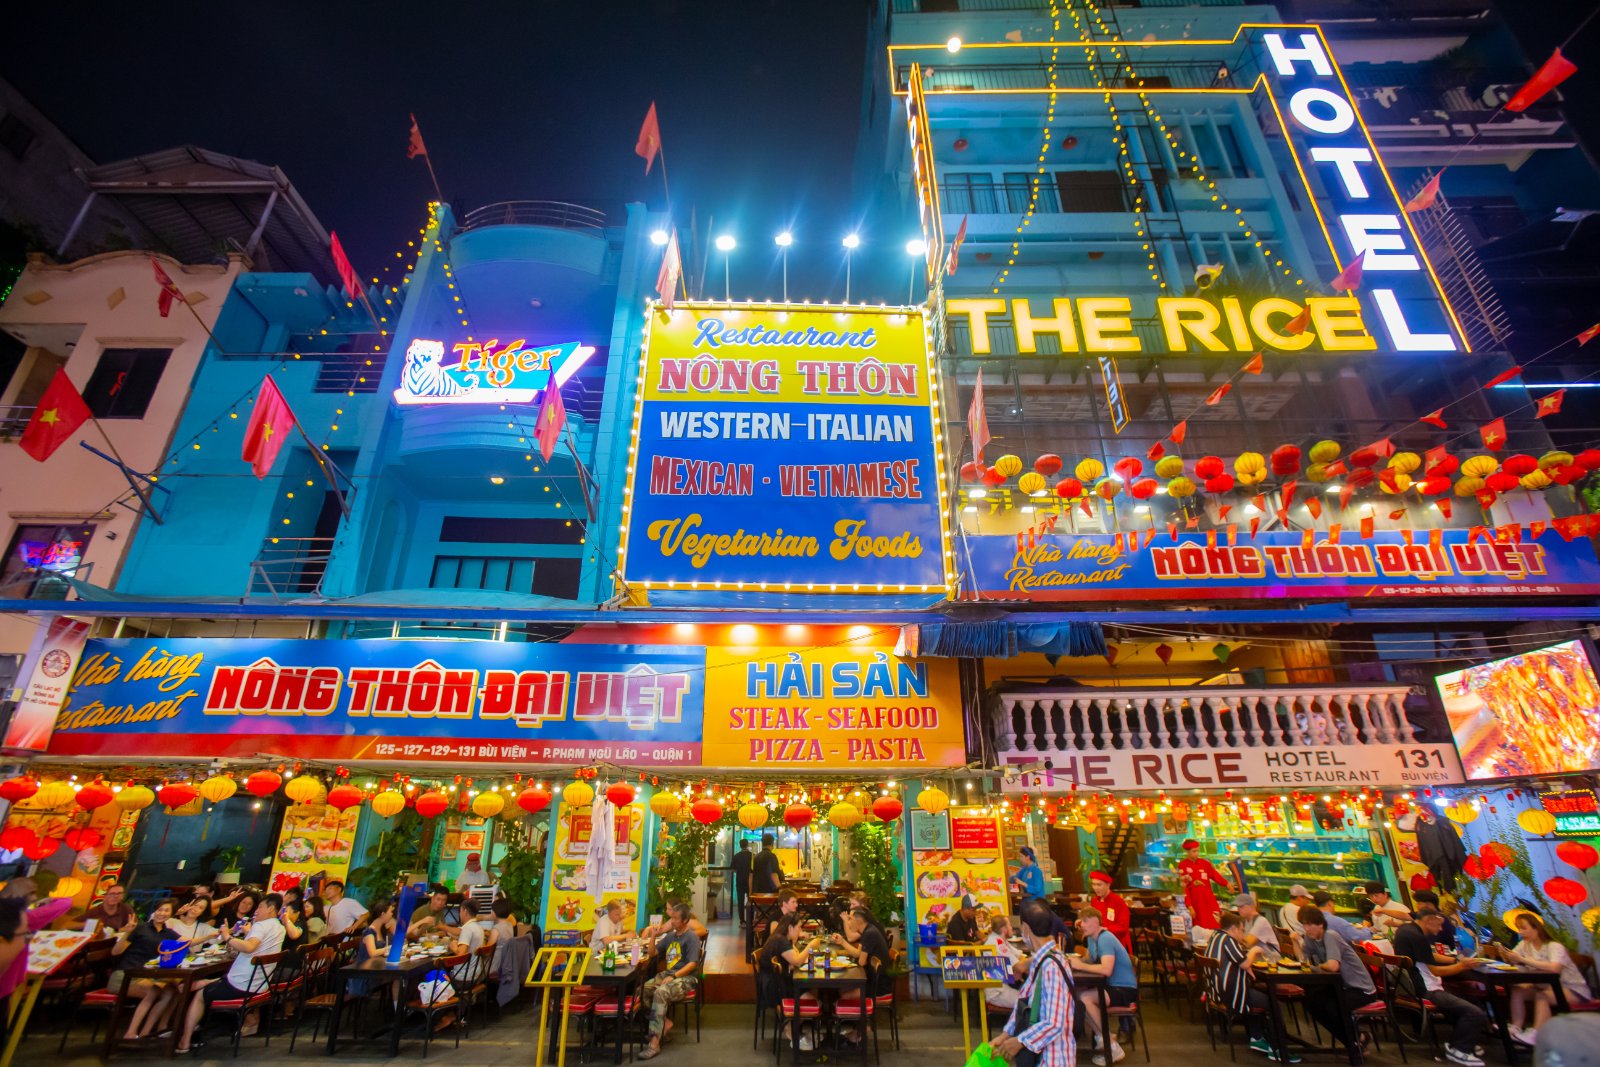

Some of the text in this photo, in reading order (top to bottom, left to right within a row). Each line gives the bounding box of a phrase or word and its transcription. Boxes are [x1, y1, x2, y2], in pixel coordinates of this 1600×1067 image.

[1263, 34, 1457, 351] HOTEL
[692, 318, 877, 349] Restaurant
[946, 297, 1378, 354] THE RICE
[452, 339, 562, 388] Tiger
[657, 353, 918, 398] NÔNG THÔN
[649, 455, 754, 496] MEXICAN
[779, 459, 922, 499] VIETNAMESE
[647, 513, 923, 568] Vegetarian Foods
[1150, 540, 1267, 580] NÔNG
[1375, 543, 1454, 581] ĐẠI
[1004, 563, 1133, 593] Restaurant
[123, 646, 204, 692] hàng
[746, 652, 930, 699] HẢI SẢN
[56, 690, 199, 730] estaurant
[203, 657, 690, 730] NÔNG THÔN ĐẠI VIỆT
[730, 707, 811, 730] STEAK
[827, 706, 939, 730] SEAFOOD
[375, 743, 475, 758] 125-127-129-131
[652, 747, 684, 762] QUẬN
[687, 750, 693, 760] 1
[749, 738, 826, 762] PIZZA
[847, 738, 926, 762] PASTA
[1006, 749, 1446, 788] THE RICE HOTEL 131
[1270, 770, 1381, 783] RESTAURANT
